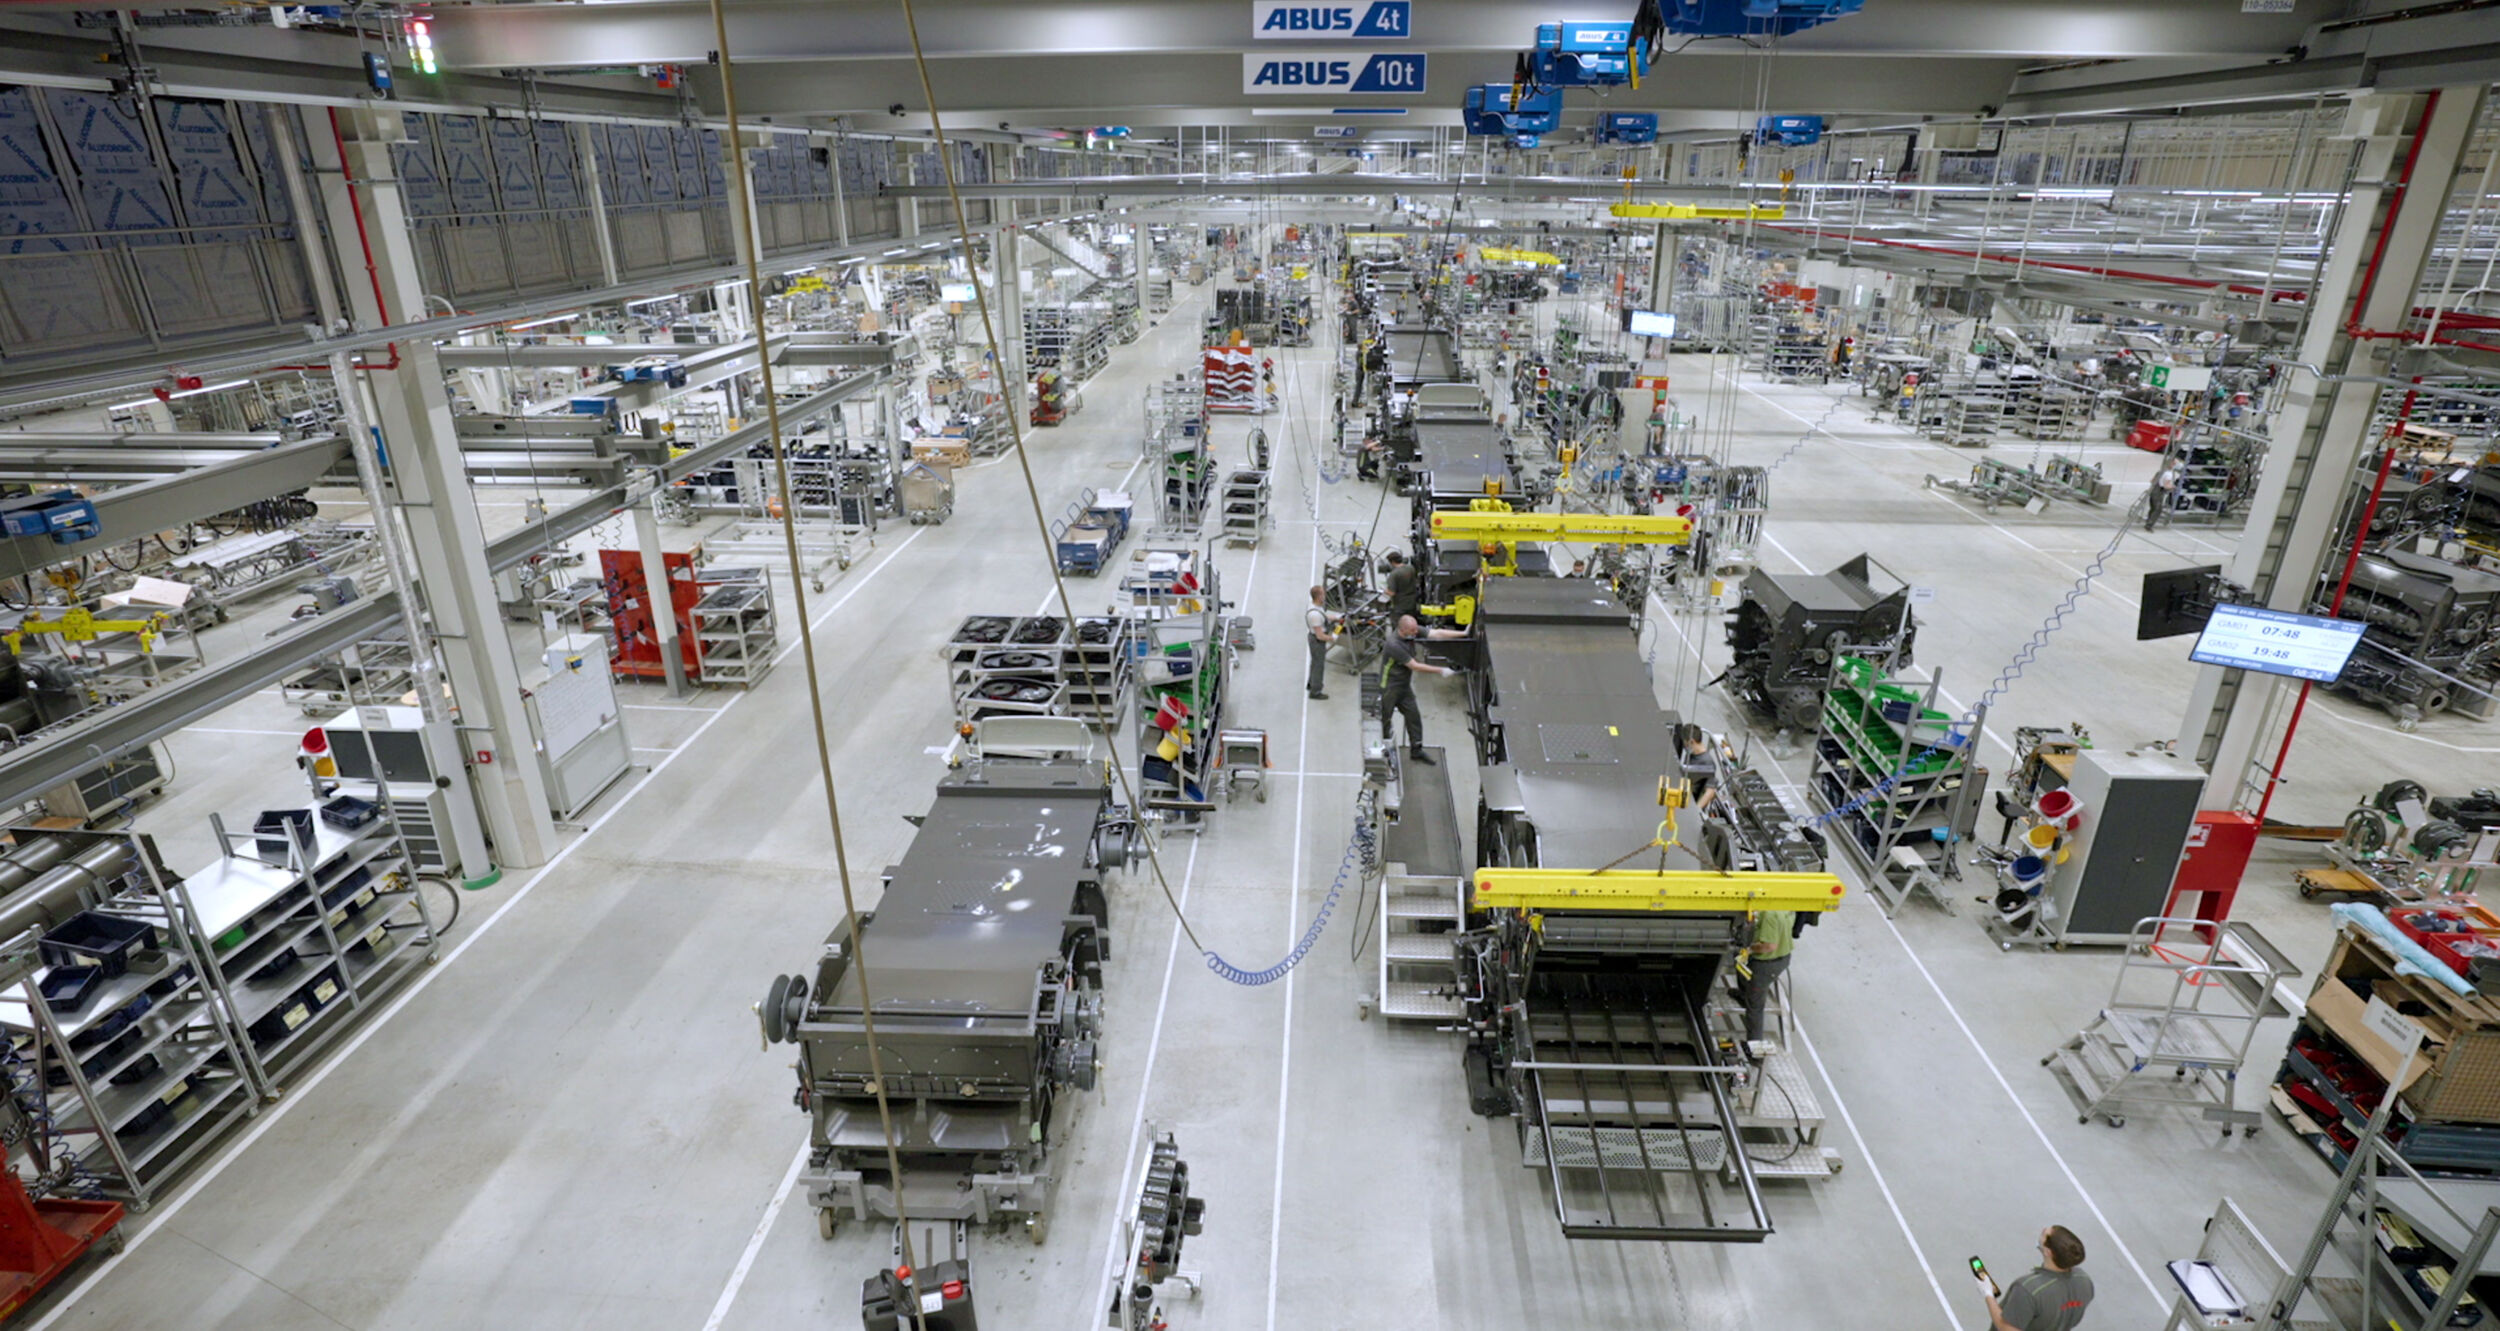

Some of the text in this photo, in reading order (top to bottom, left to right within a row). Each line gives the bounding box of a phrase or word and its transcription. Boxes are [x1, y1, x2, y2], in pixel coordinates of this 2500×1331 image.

[1262, 7, 1400, 31] ABUS 4t
[1253, 61, 1350, 85] ABUS
[2262, 626, 2301, 640] 07:48
[2251, 646, 2290, 660] 19:48
